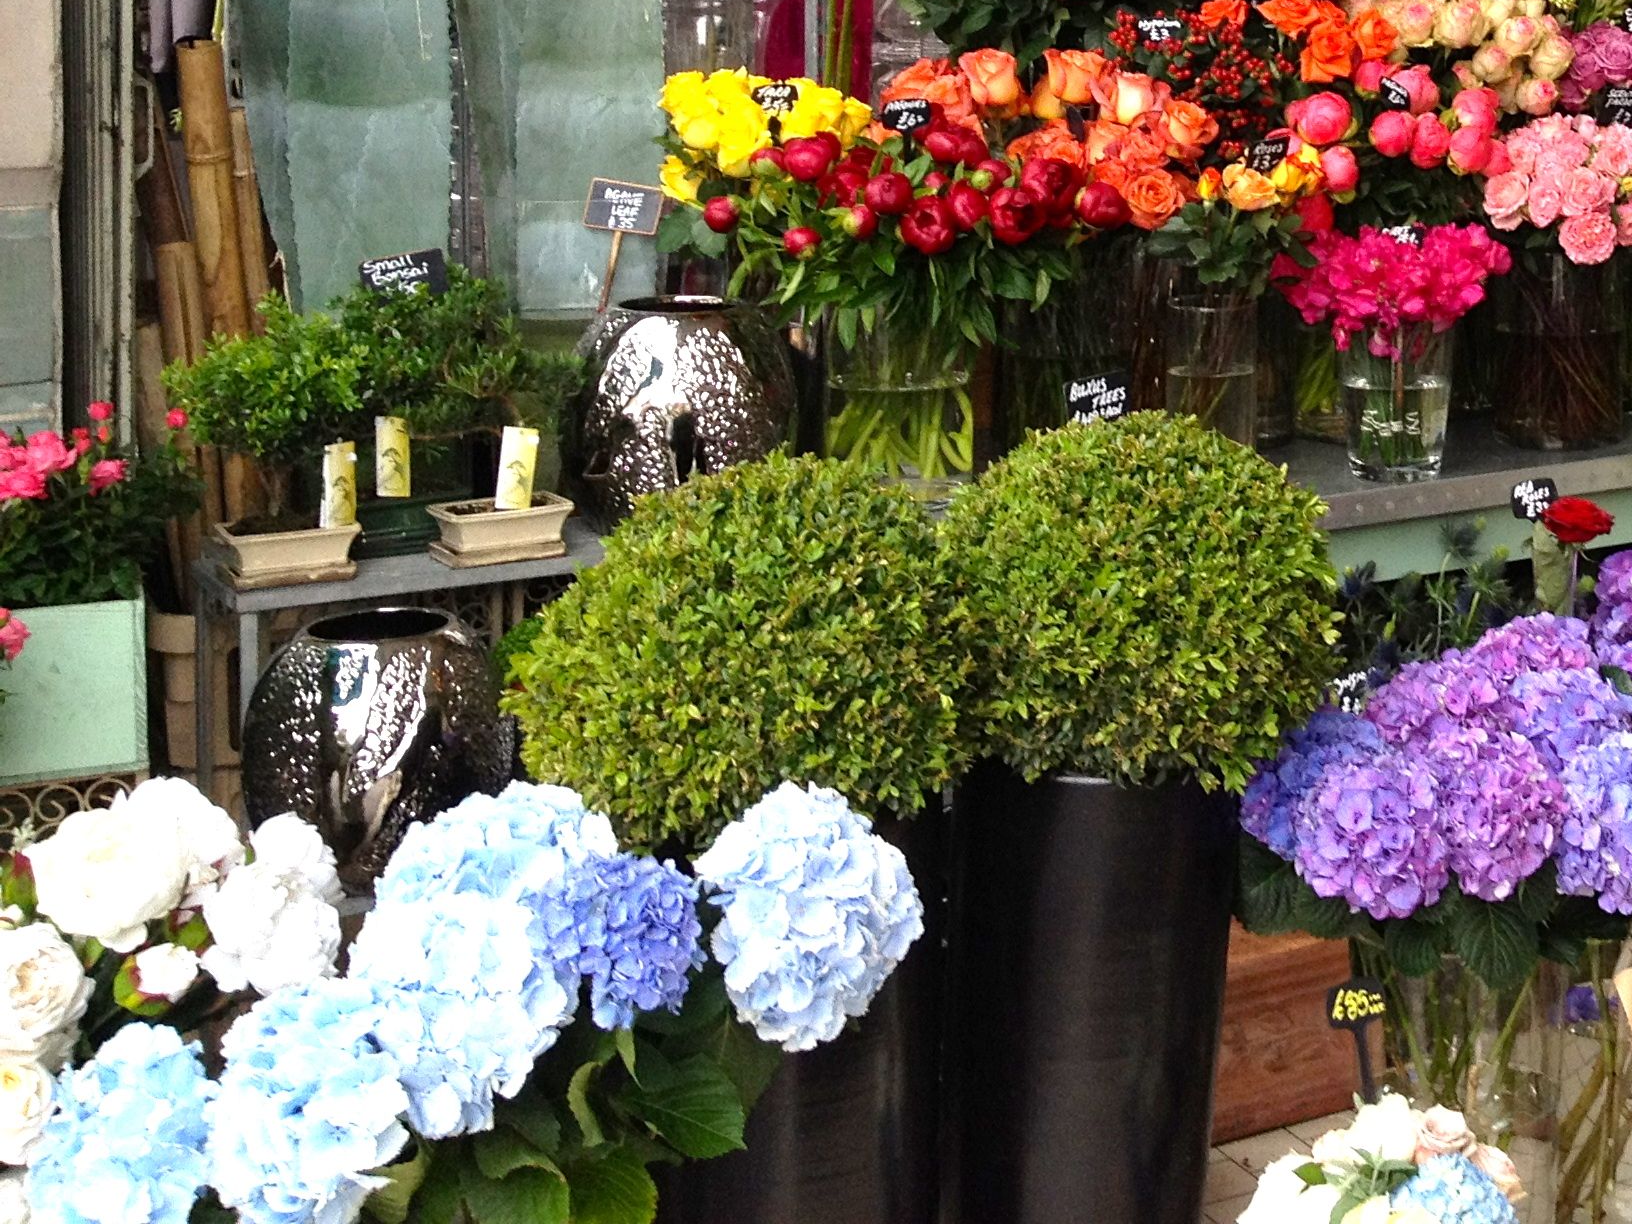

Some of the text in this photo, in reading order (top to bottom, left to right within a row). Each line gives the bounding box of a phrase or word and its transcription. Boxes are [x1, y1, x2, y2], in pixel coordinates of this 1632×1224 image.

[363, 254, 413, 274] Small
[1070, 377, 1107, 402] BUXUS
[1091, 386, 1126, 409] TREES
